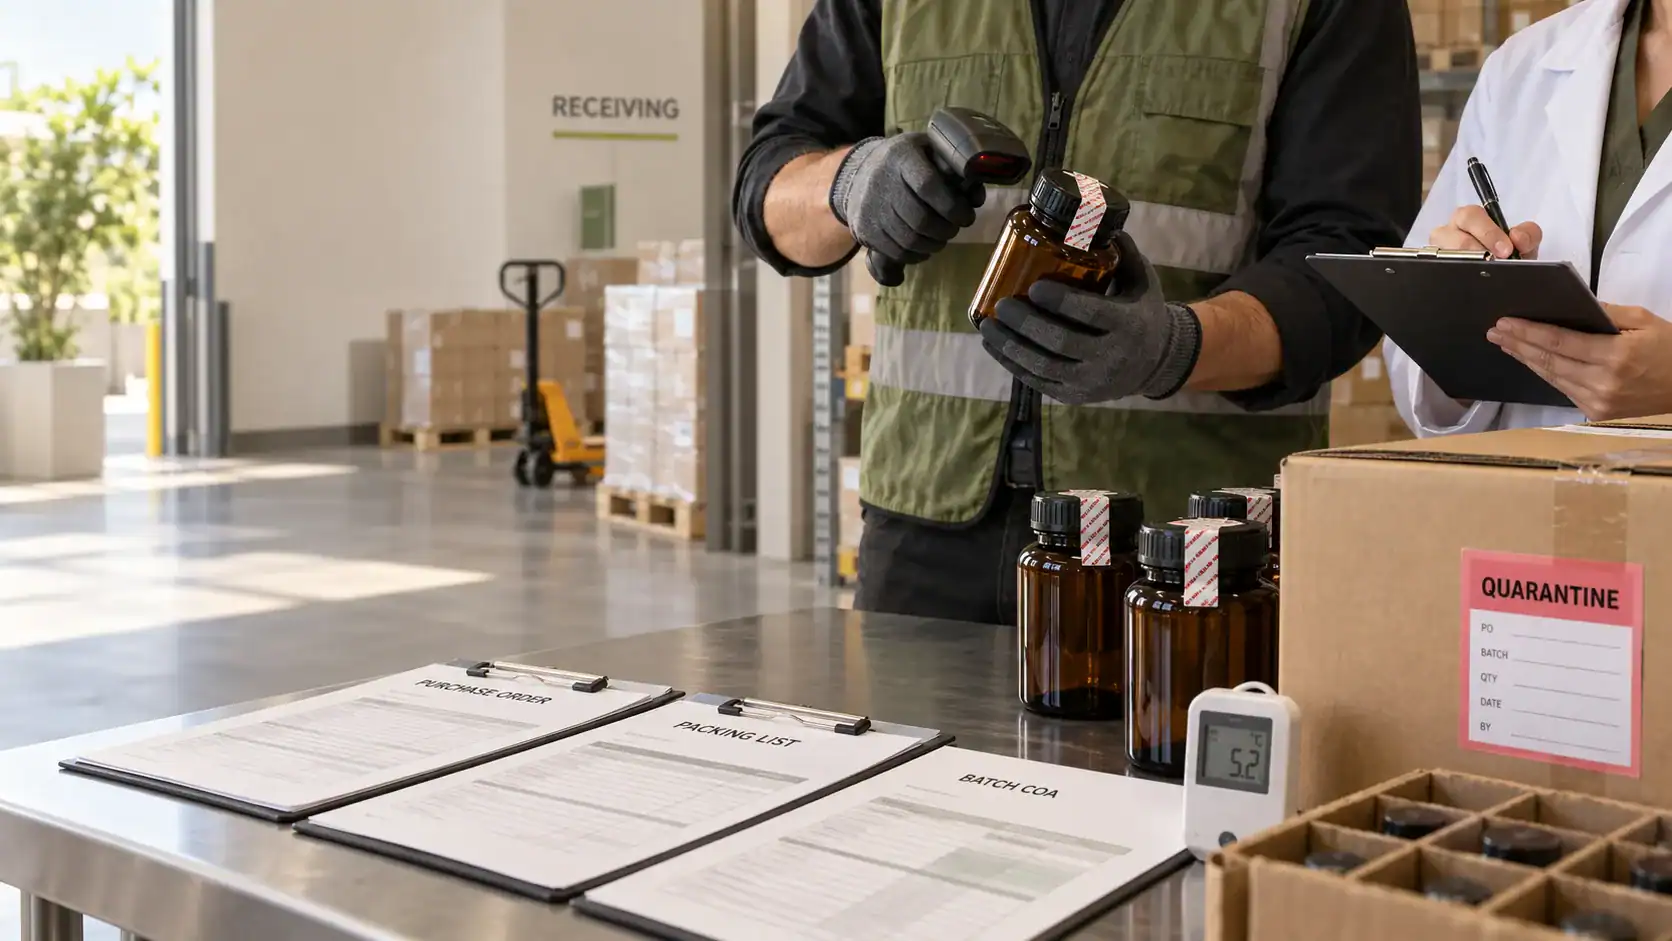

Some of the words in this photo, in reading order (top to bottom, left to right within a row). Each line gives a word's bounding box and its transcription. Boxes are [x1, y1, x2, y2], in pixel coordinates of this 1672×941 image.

[552, 95, 680, 120] RECEIVING
[1481, 576, 1619, 610] QUARANTINE
[1481, 623, 1493, 634] PO
[1480, 647, 1509, 660] BATCH
[1480, 673, 1498, 684] QTY
[415, 679, 498, 697] PURCHASE
[496, 691, 553, 705] ORDER
[1480, 697, 1502, 709] DATE
[673, 721, 757, 741] PACKING
[756, 734, 802, 748] LIST
[1479, 722, 1492, 732] BY
[1229, 748, 1260, 780] 5.2
[958, 773, 1021, 791] BATCH
[1020, 785, 1059, 799] COA
